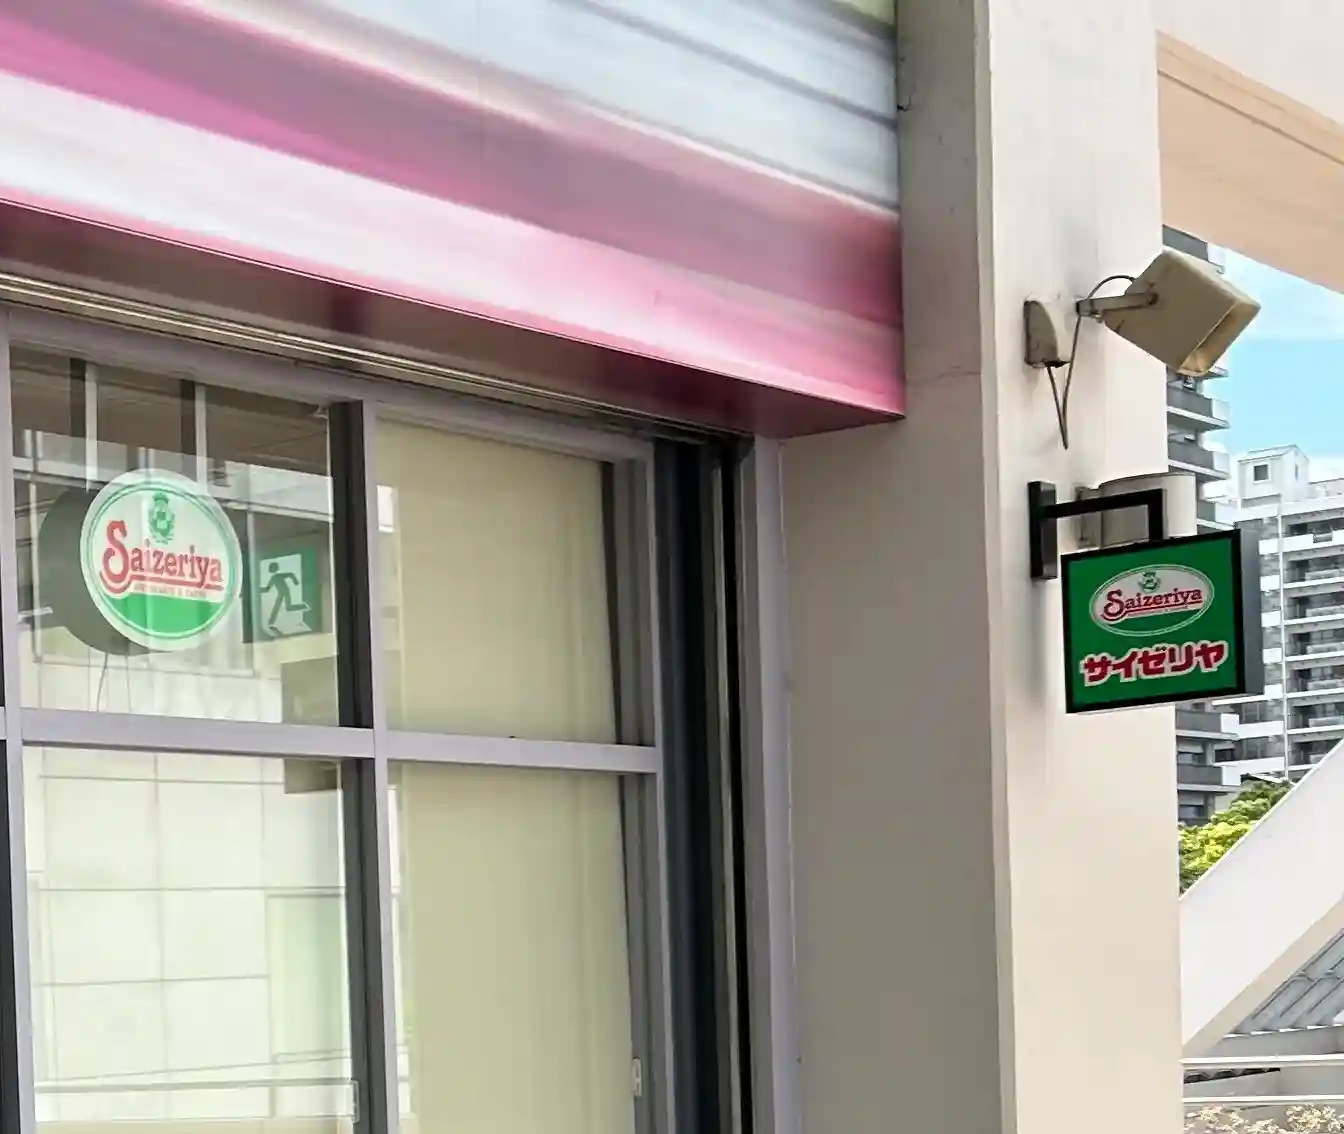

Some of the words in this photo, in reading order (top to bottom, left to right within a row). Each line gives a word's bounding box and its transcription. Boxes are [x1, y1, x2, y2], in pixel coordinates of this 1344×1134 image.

[100, 520, 224, 595] Saizeriya
[1101, 588, 1203, 622] Saizeriya
[1081, 641, 1229, 687] サイゼリヤ
